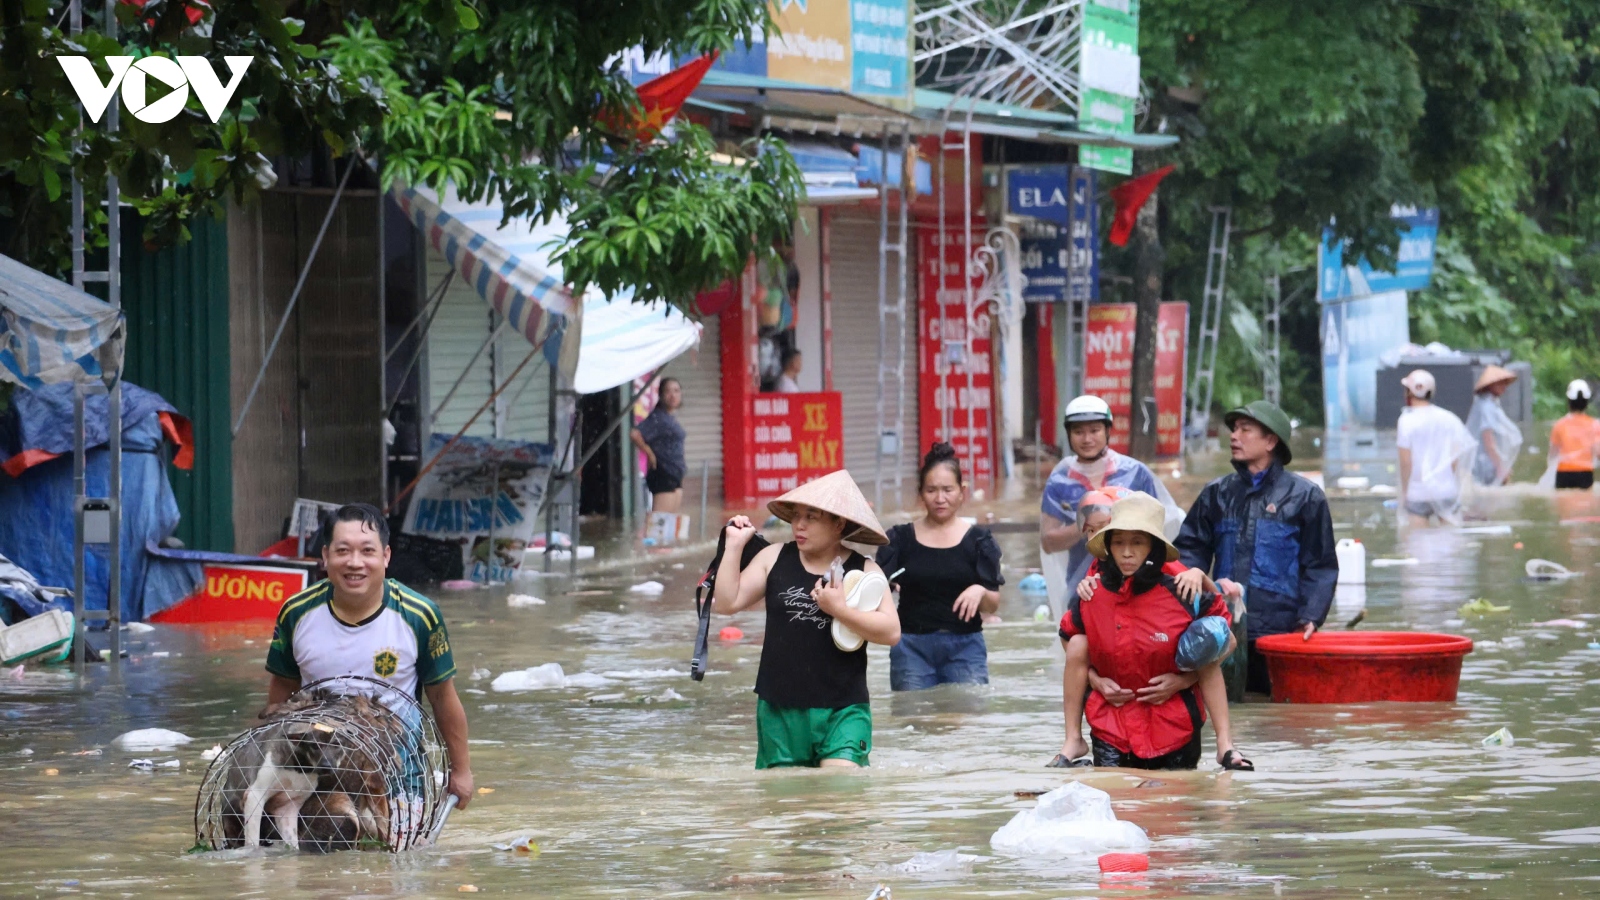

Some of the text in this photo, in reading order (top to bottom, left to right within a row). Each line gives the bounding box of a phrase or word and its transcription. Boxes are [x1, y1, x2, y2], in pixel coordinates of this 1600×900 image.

[1019, 187, 1085, 207] ELAN
[803, 403, 829, 431] XE
[800, 433, 839, 468] MÁY
